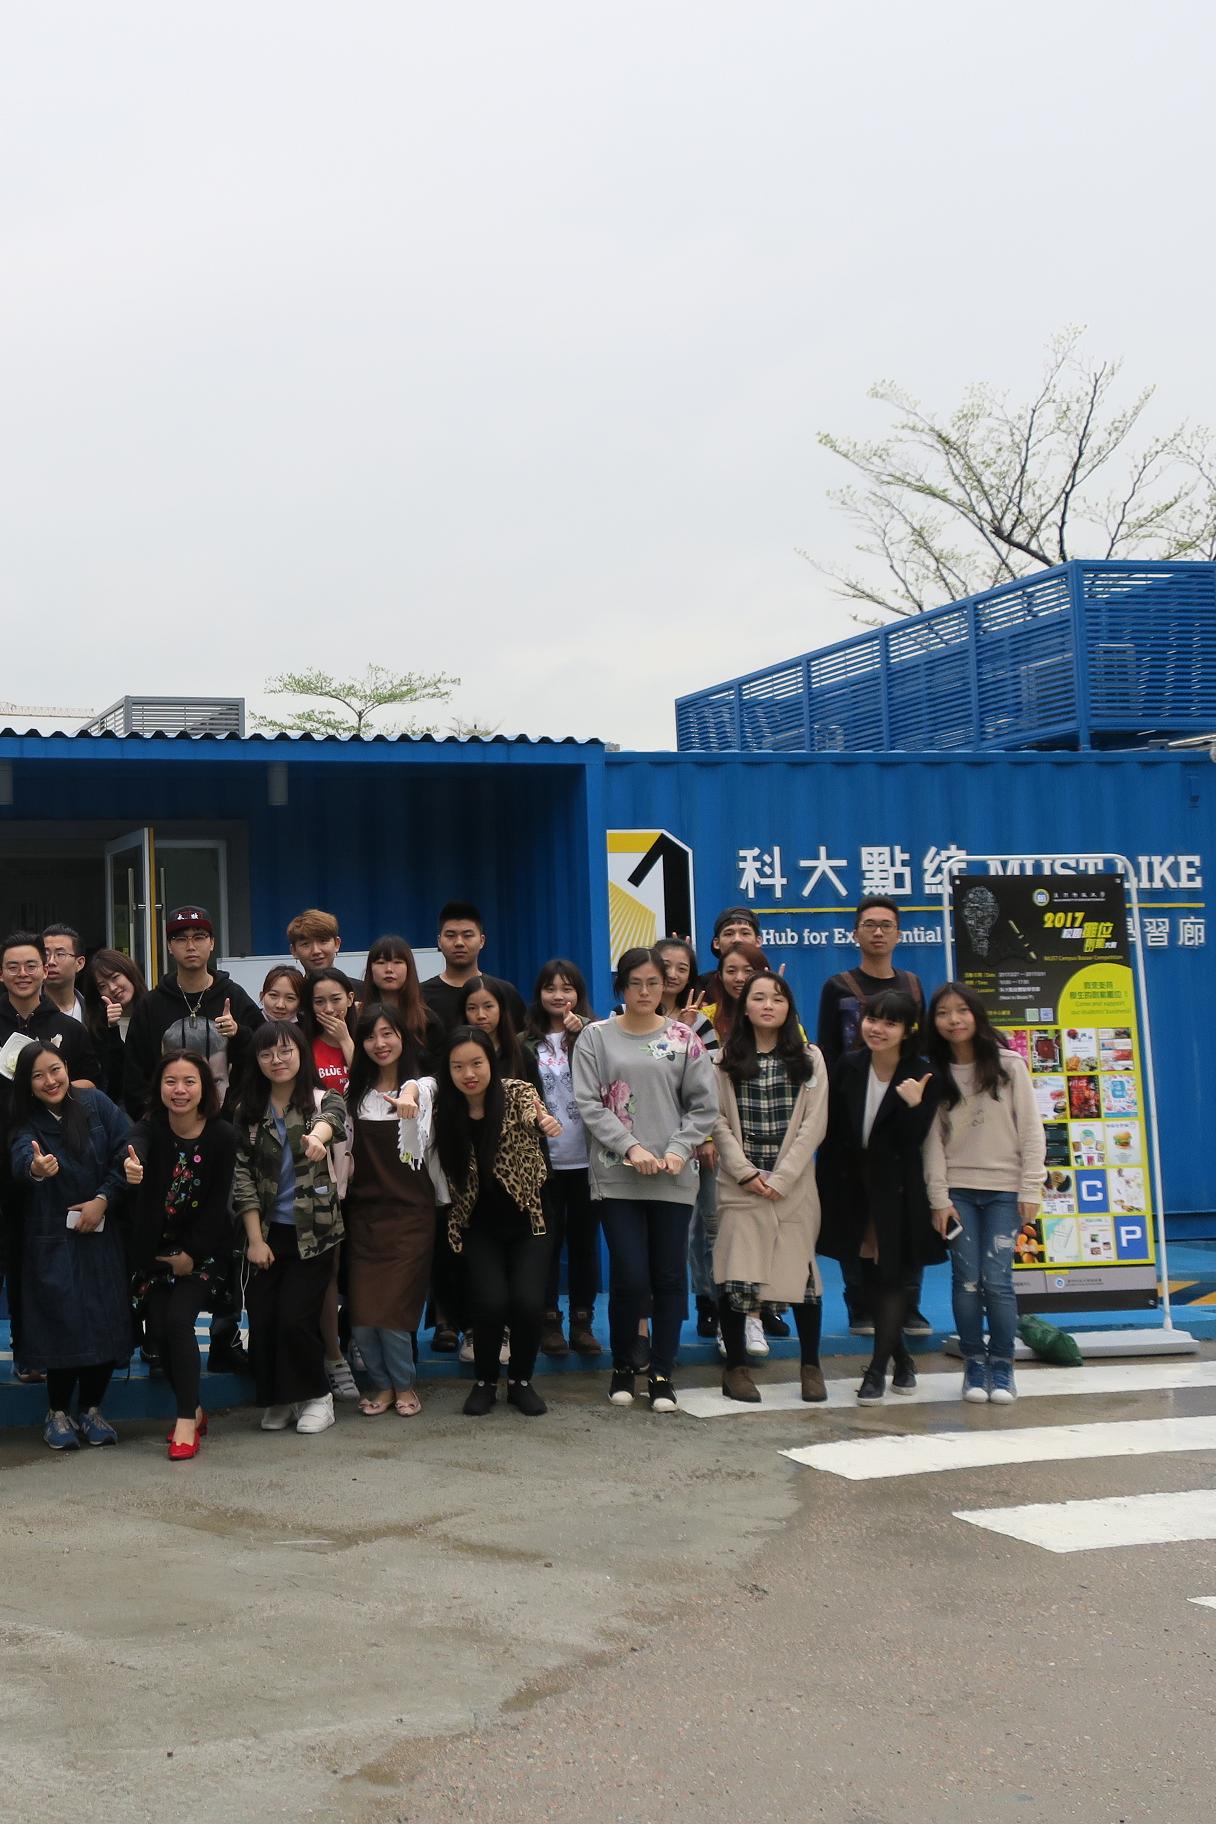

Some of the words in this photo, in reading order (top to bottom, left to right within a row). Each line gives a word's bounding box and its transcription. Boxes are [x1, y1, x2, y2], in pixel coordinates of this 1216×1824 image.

[1043, 911, 1085, 928] 2017
[762, 928, 799, 946] Hub
[803, 928, 829, 945] for
[1081, 1180, 1104, 1201] C
[1119, 1225, 1142, 1248] P
